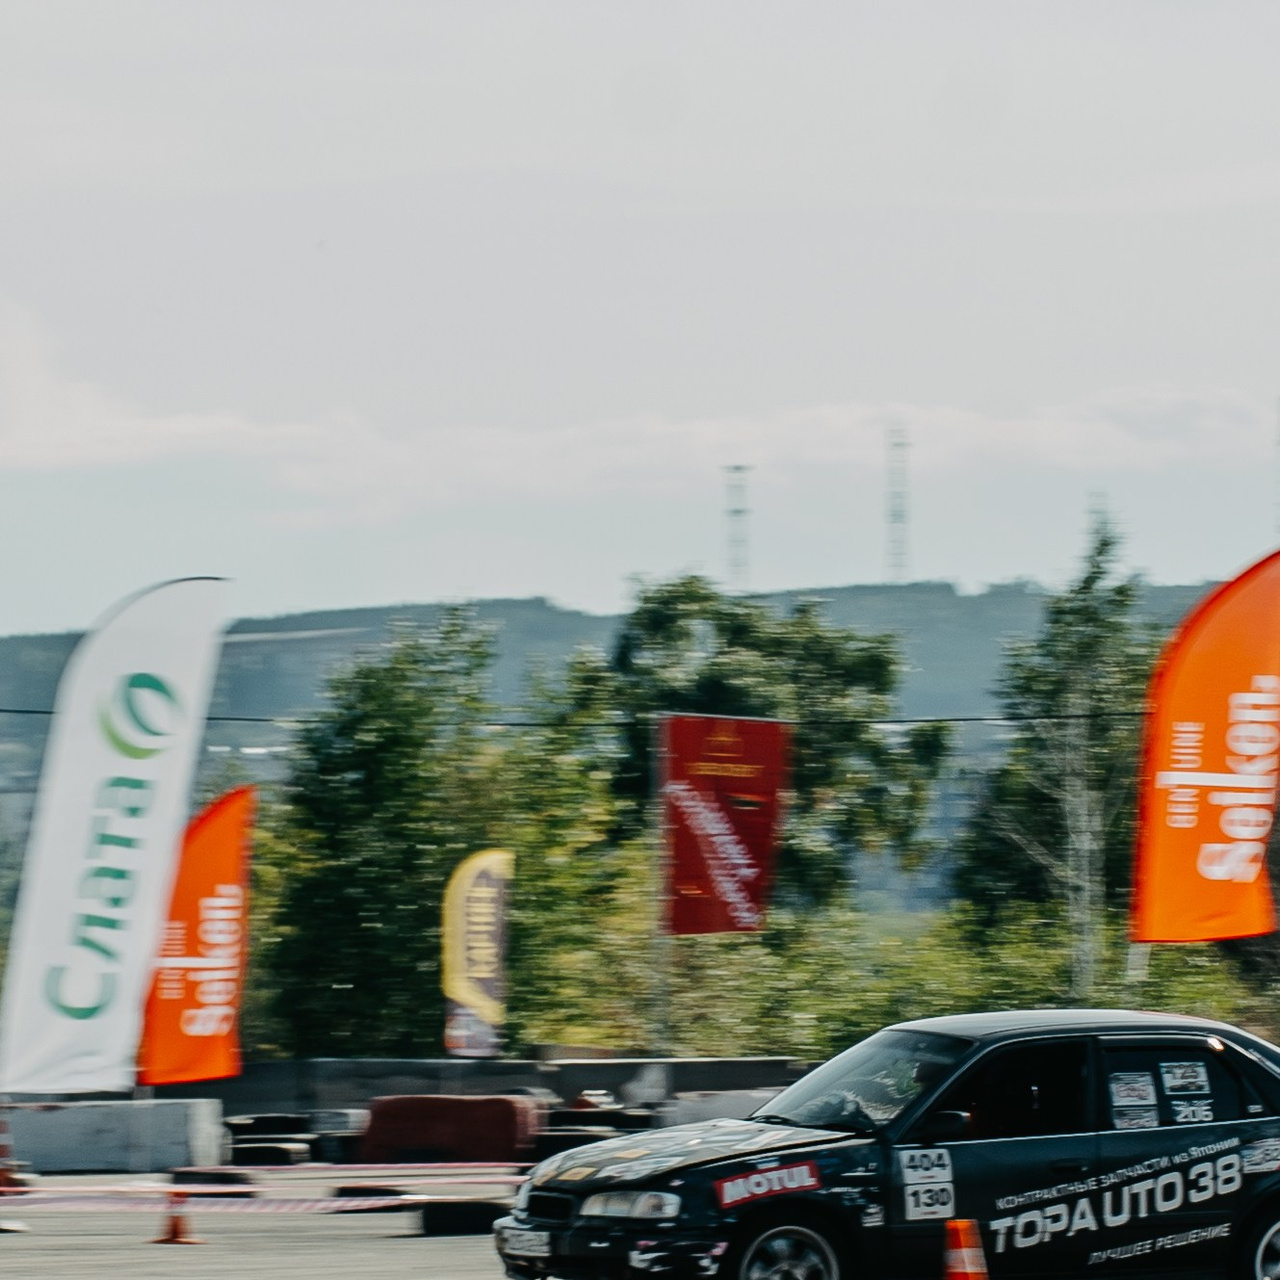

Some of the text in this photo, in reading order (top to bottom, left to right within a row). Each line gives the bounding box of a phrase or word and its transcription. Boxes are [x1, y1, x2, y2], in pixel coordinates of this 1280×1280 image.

[44, 774, 154, 1021] Слата
[906, 1152, 949, 1172] 404
[721, 1165, 818, 1205] MOTUL
[908, 1187, 952, 1209] 130
[1154, 1222, 1233, 1251] РЕШЕНИЕ
